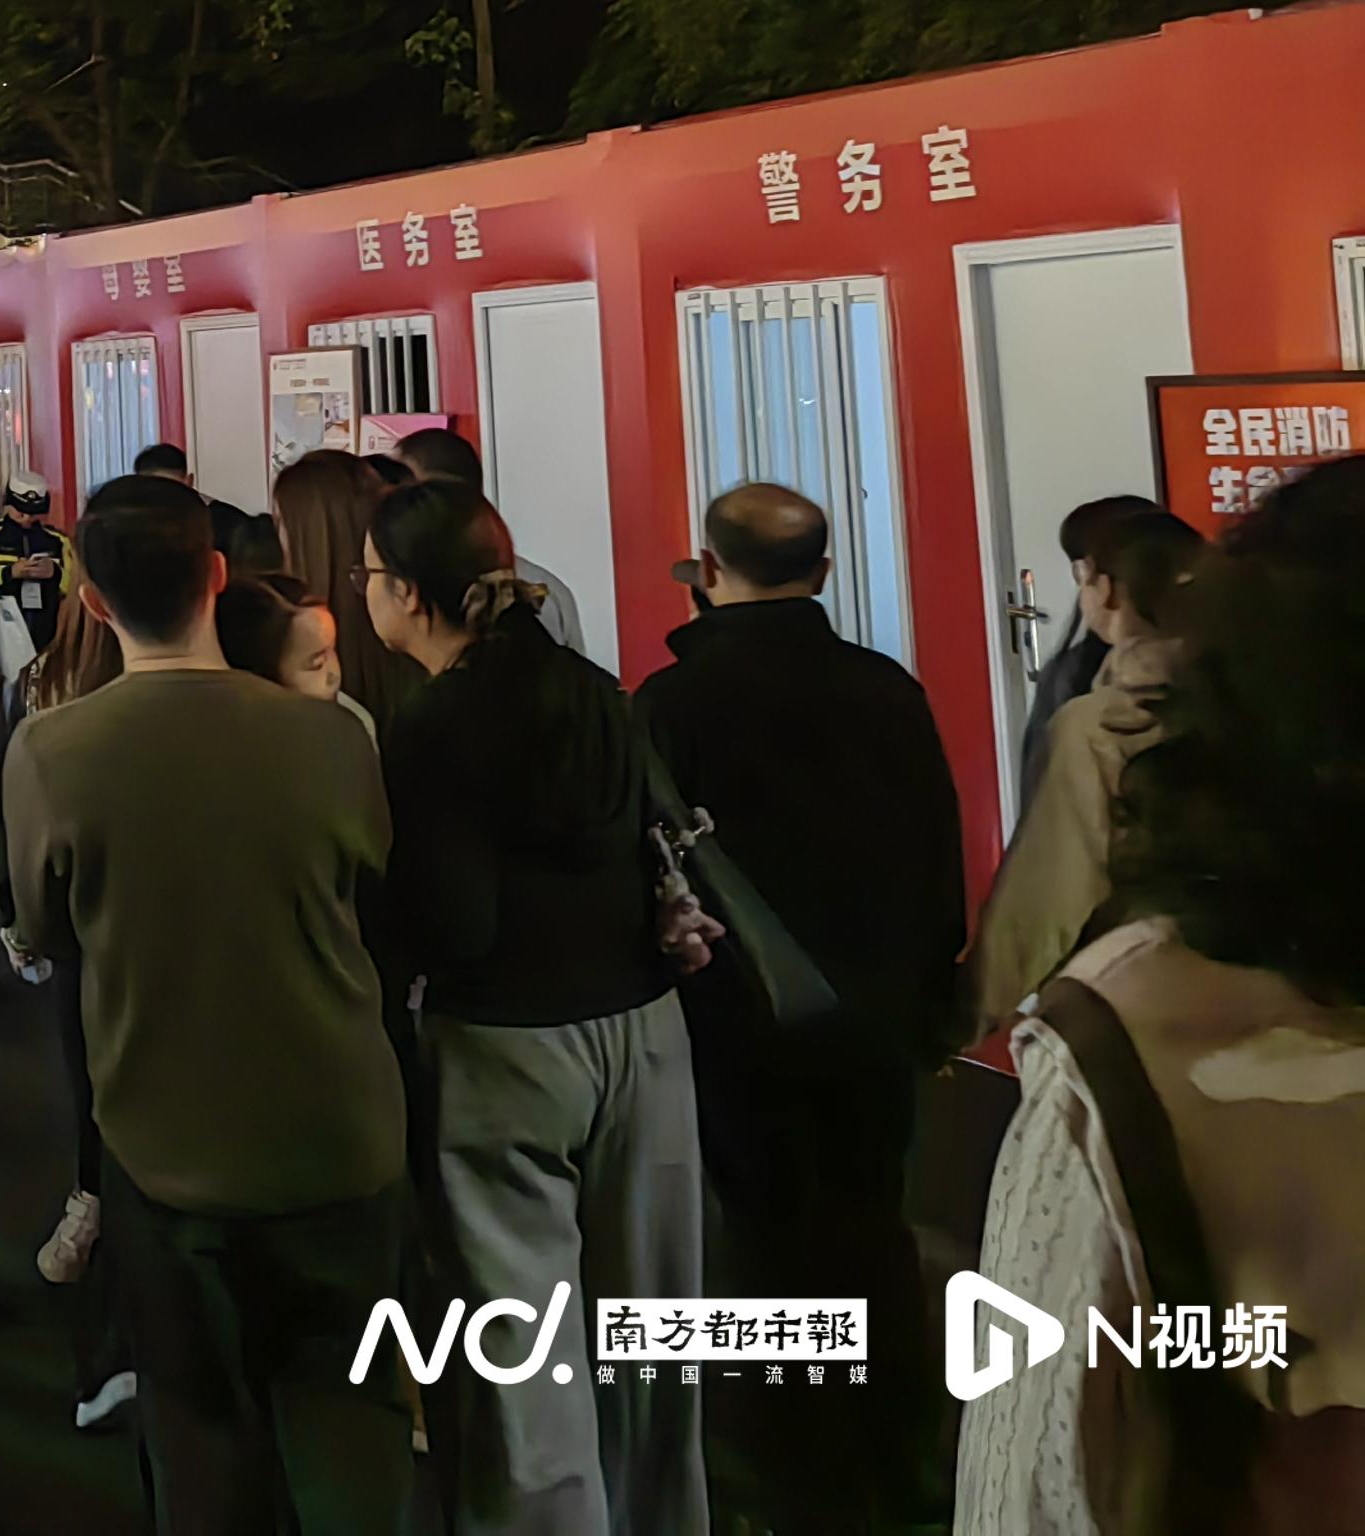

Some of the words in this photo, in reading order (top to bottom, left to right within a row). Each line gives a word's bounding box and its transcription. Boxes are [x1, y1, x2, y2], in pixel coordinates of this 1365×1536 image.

[757, 125, 977, 224] 警务室
[356, 203, 483, 272] 医务室
[1203, 406, 1350, 456] 全民消防
[1209, 466, 1309, 513] 生命
